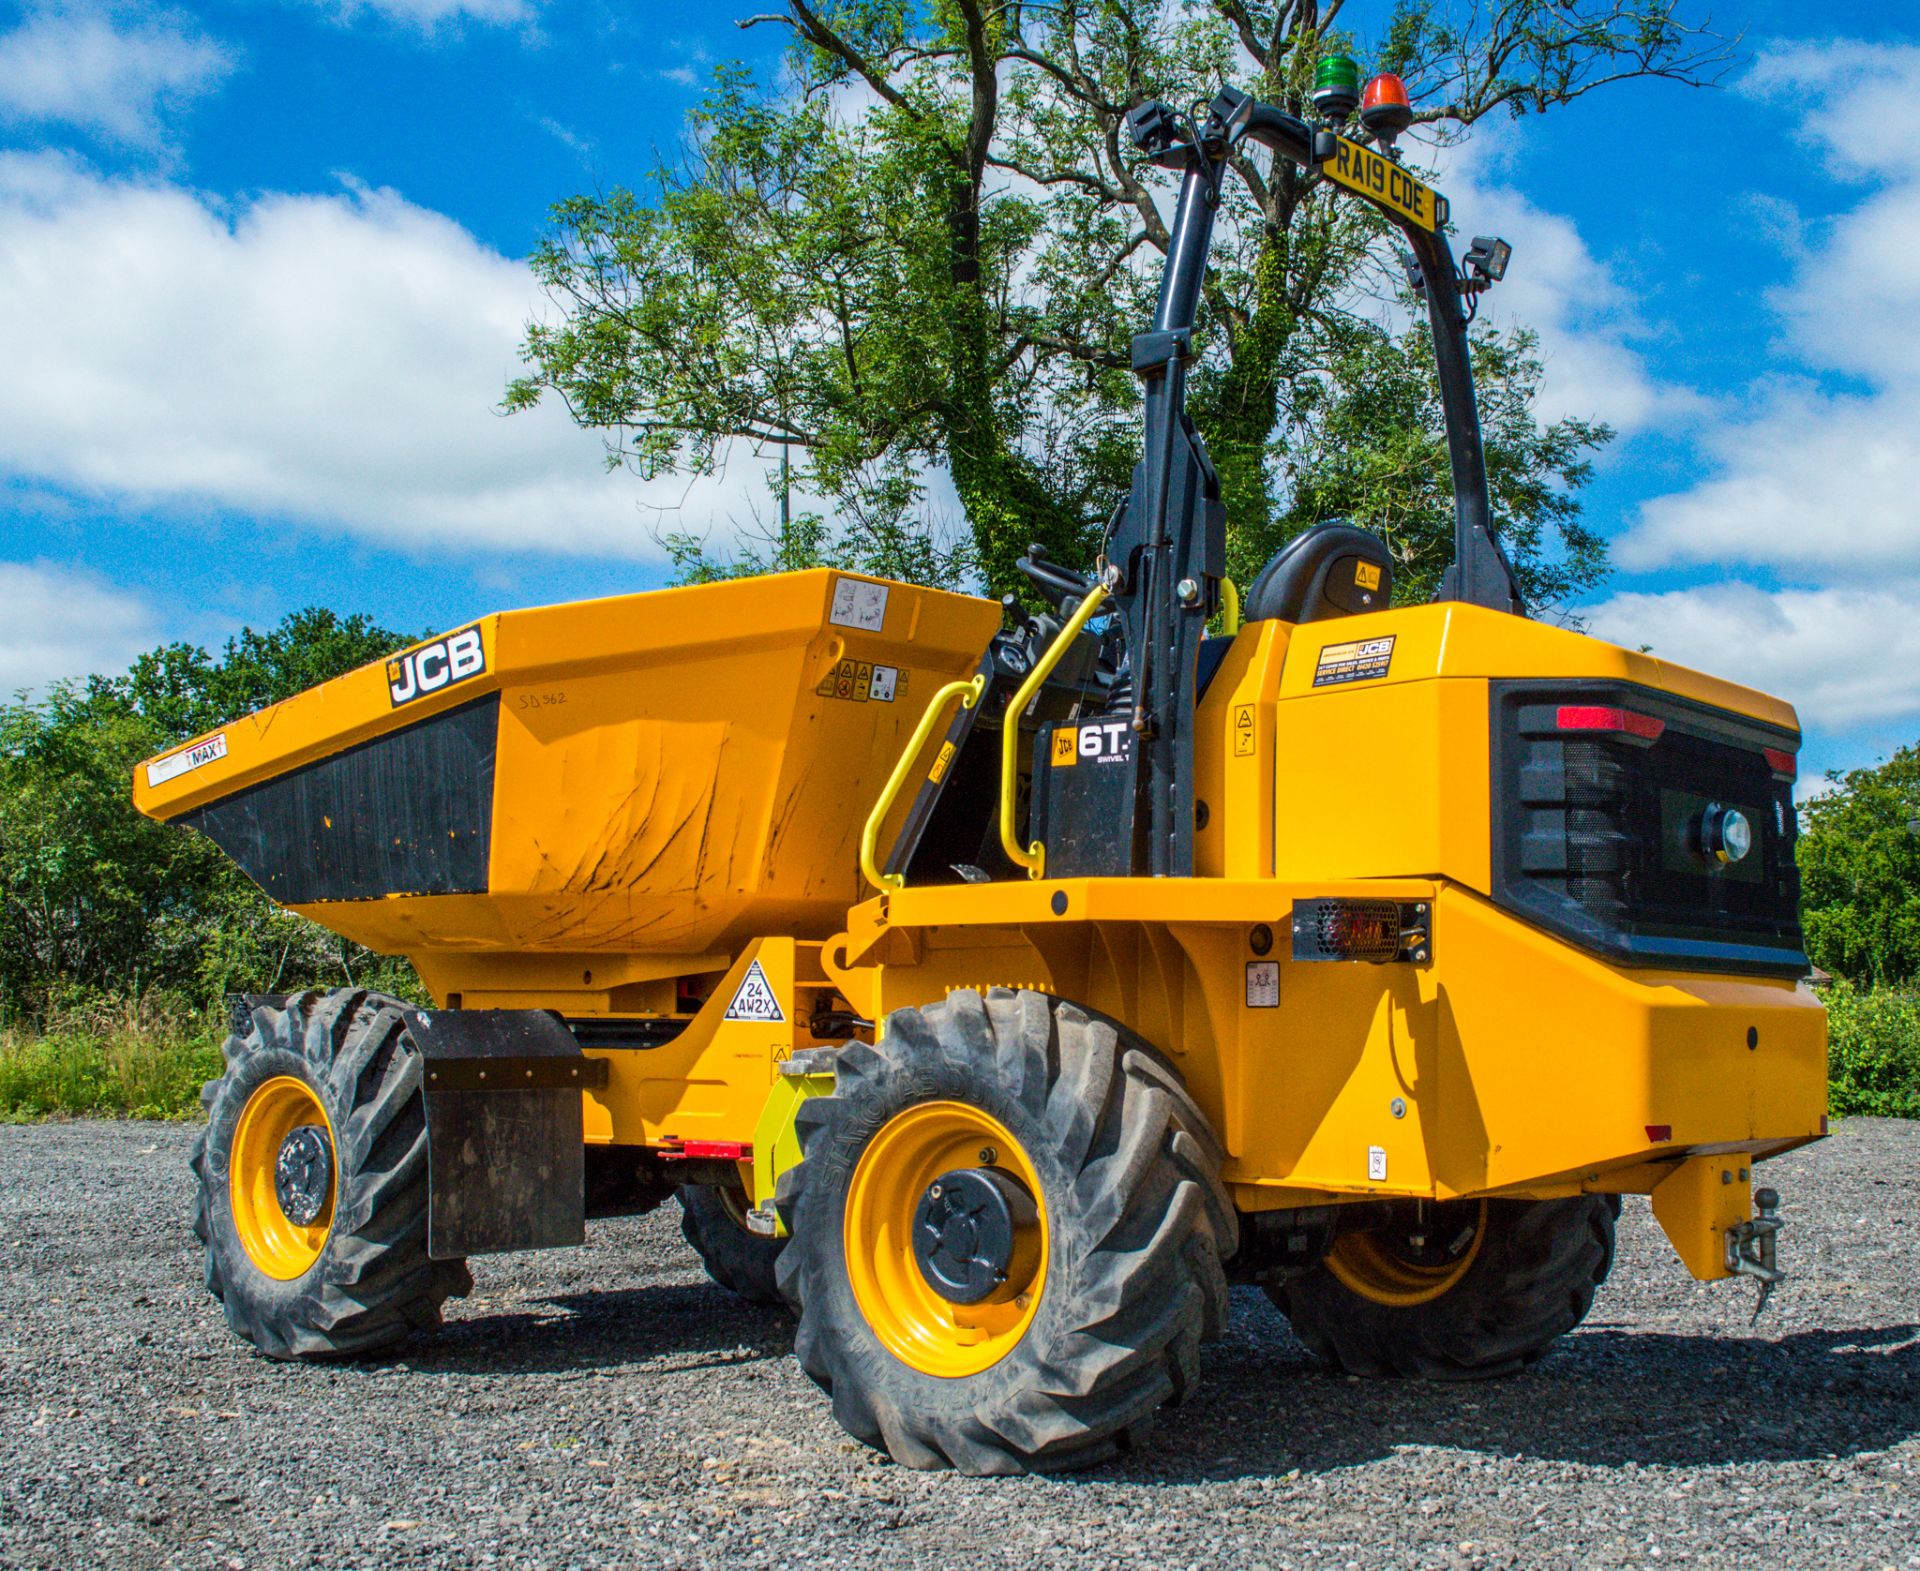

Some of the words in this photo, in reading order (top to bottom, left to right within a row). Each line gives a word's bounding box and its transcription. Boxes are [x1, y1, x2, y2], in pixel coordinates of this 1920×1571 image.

[1390, 168, 1424, 218] CDE
[1358, 640, 1390, 656] JCB
[391, 629, 483, 702] JCB
[519, 694, 540, 710] SD
[192, 743, 216, 765] MAX
[1059, 739, 1072, 755] JCB
[1097, 754, 1124, 763] SWIVEL
[747, 983, 762, 997] 24
[739, 999, 771, 1013] AW2X
